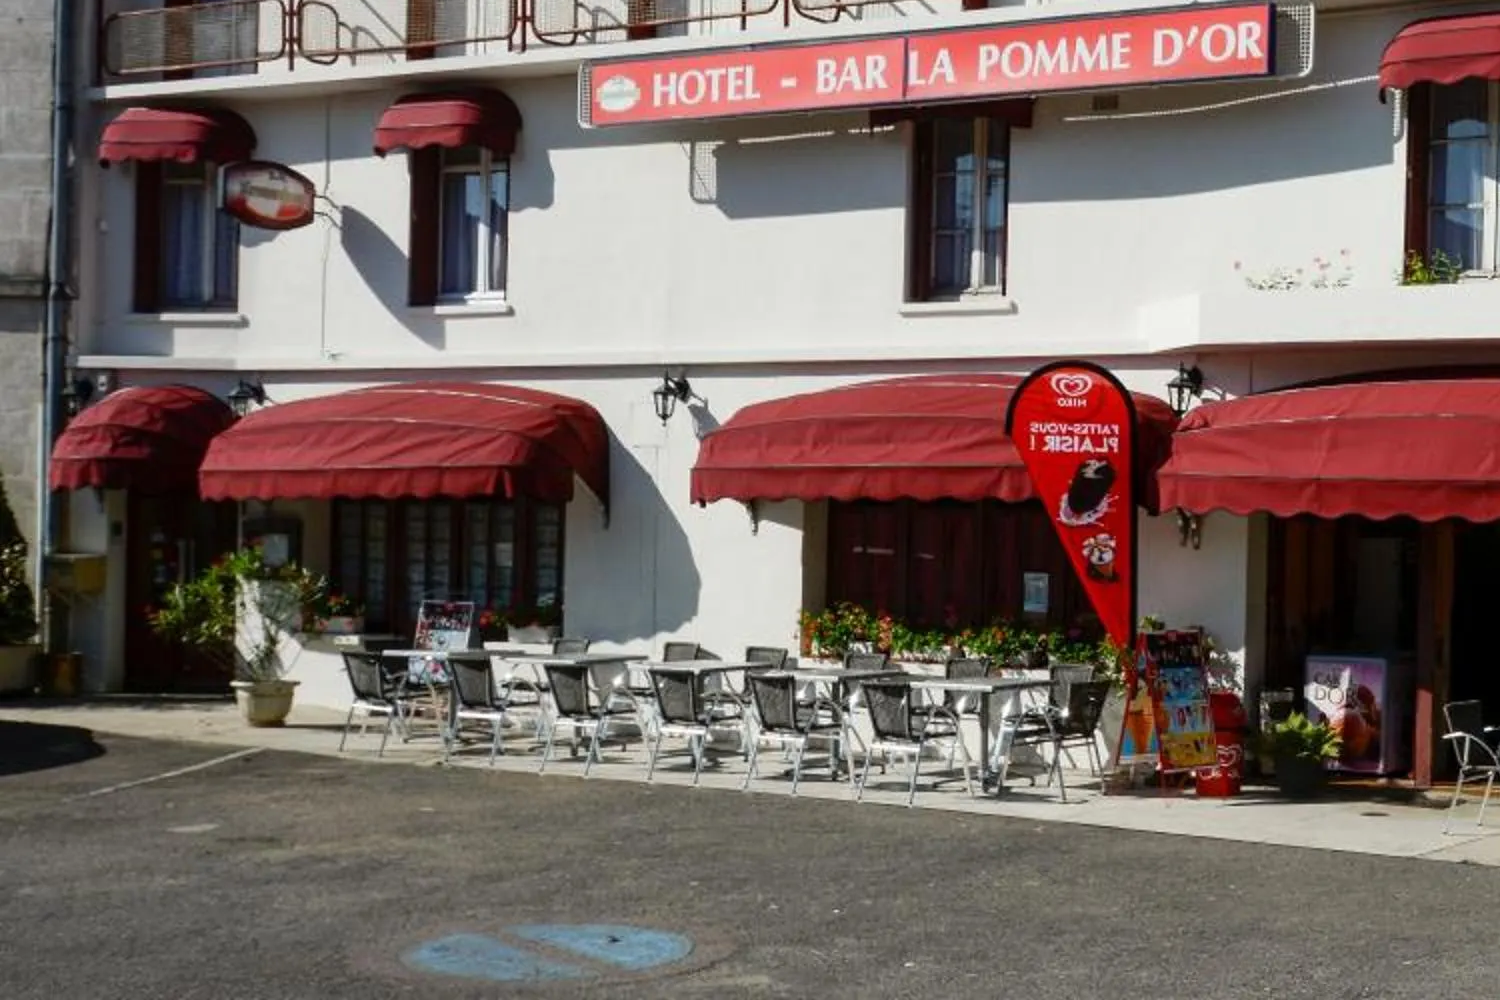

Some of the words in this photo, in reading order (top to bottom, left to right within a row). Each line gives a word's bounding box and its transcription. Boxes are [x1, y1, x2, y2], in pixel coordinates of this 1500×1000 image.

[653, 64, 761, 108] HOTEL
[815, 54, 889, 95] BAR
[907, 48, 957, 86] LA
[977, 32, 1132, 82] POMME
[1152, 21, 1264, 68] D'OR
